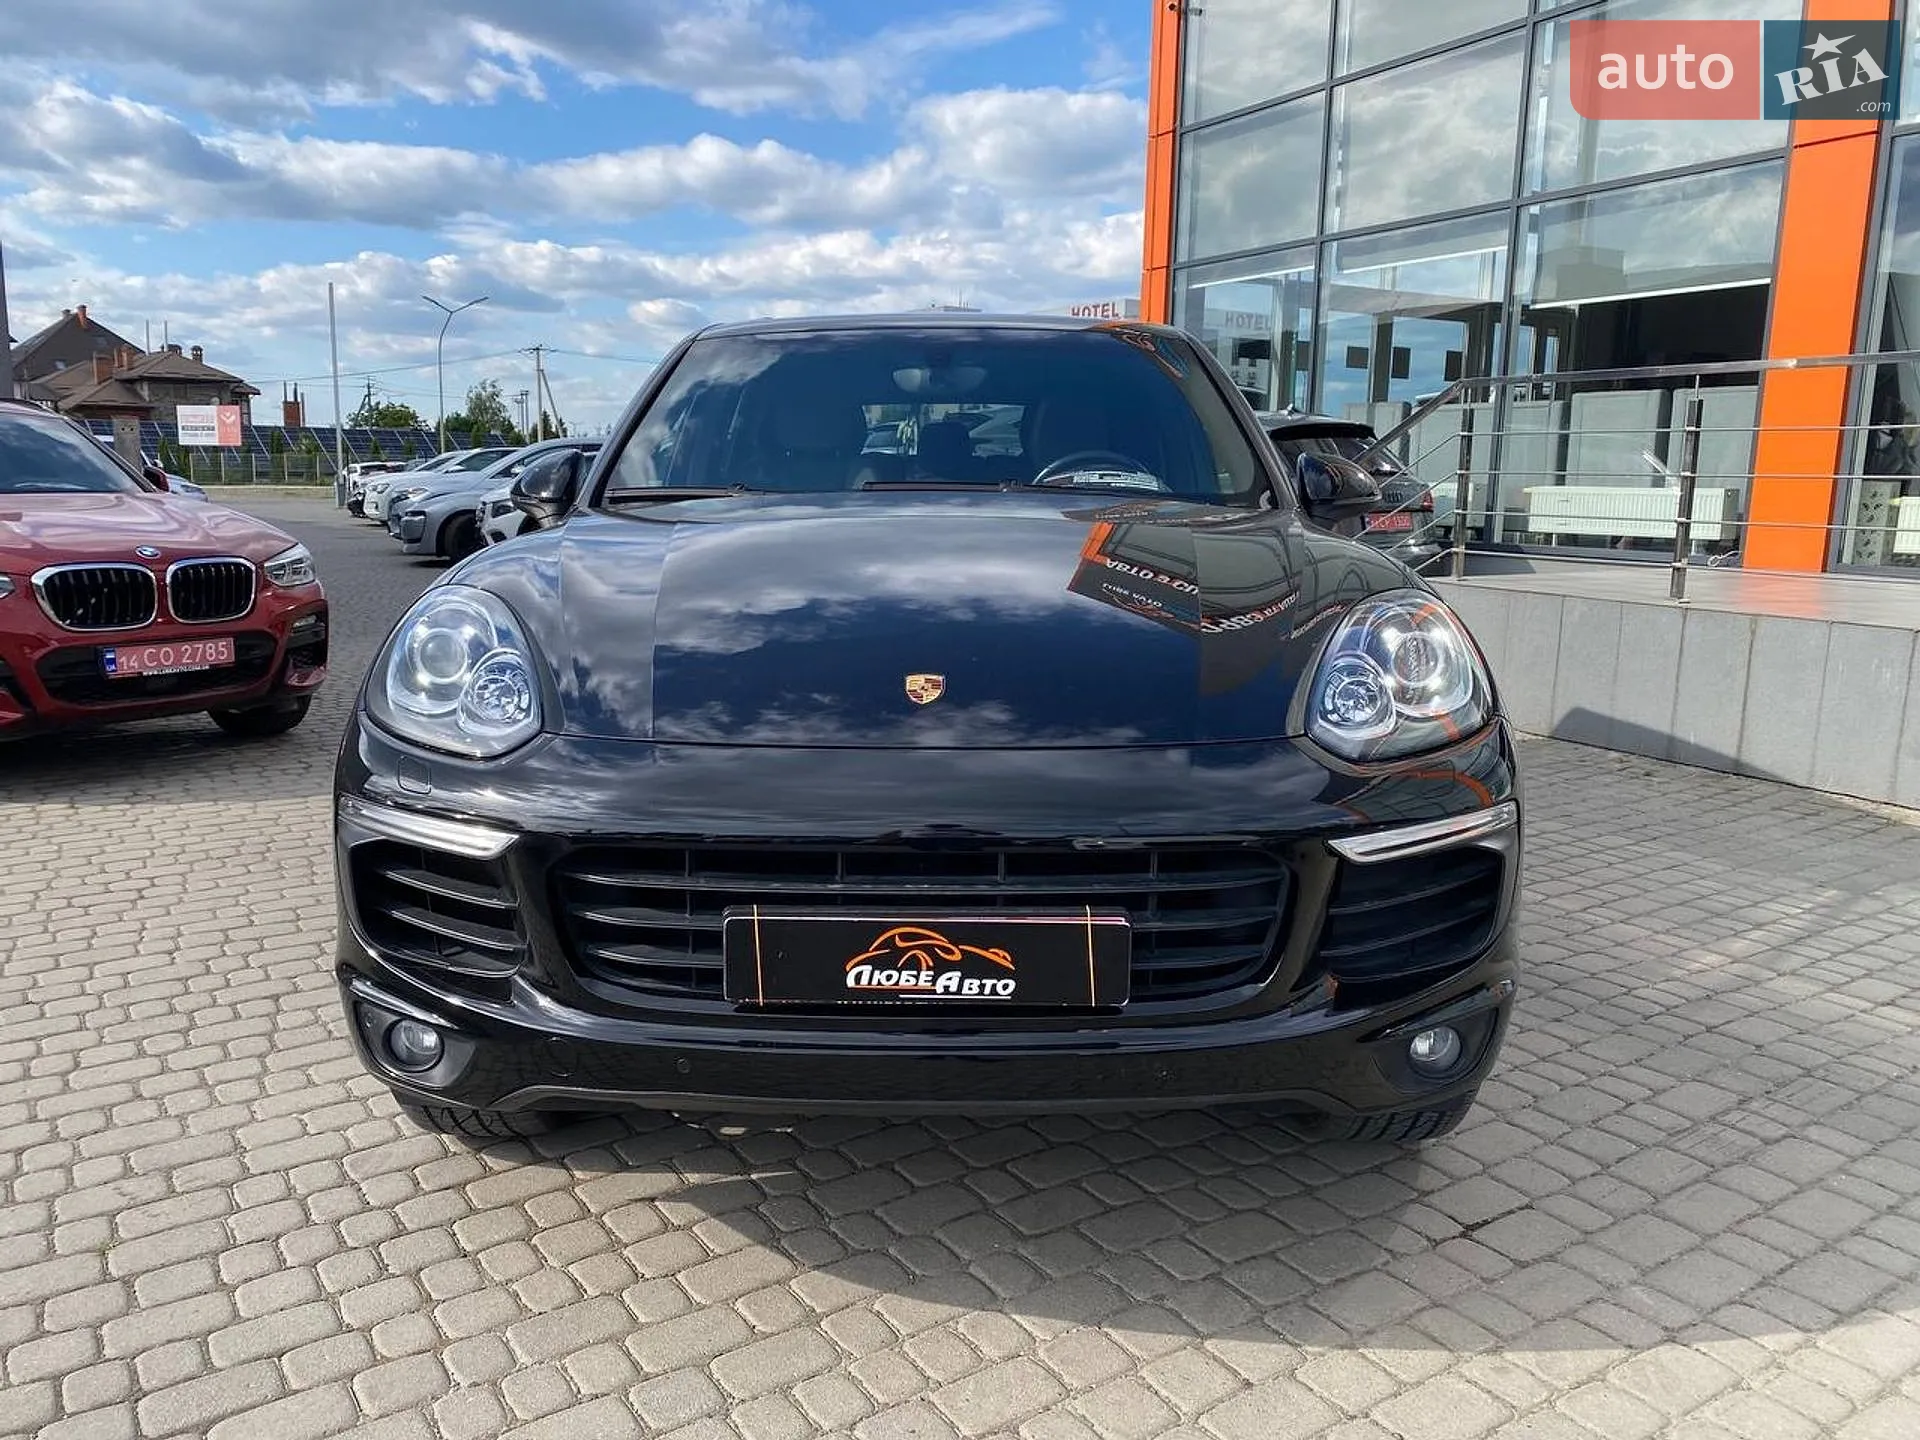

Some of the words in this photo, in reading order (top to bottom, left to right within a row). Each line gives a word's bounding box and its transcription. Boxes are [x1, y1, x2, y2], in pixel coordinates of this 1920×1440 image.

[1071, 302, 1119, 319] HOTEL
[119, 655, 139, 670] 14
[143, 647, 174, 667] CO
[181, 642, 228, 664] 2785
